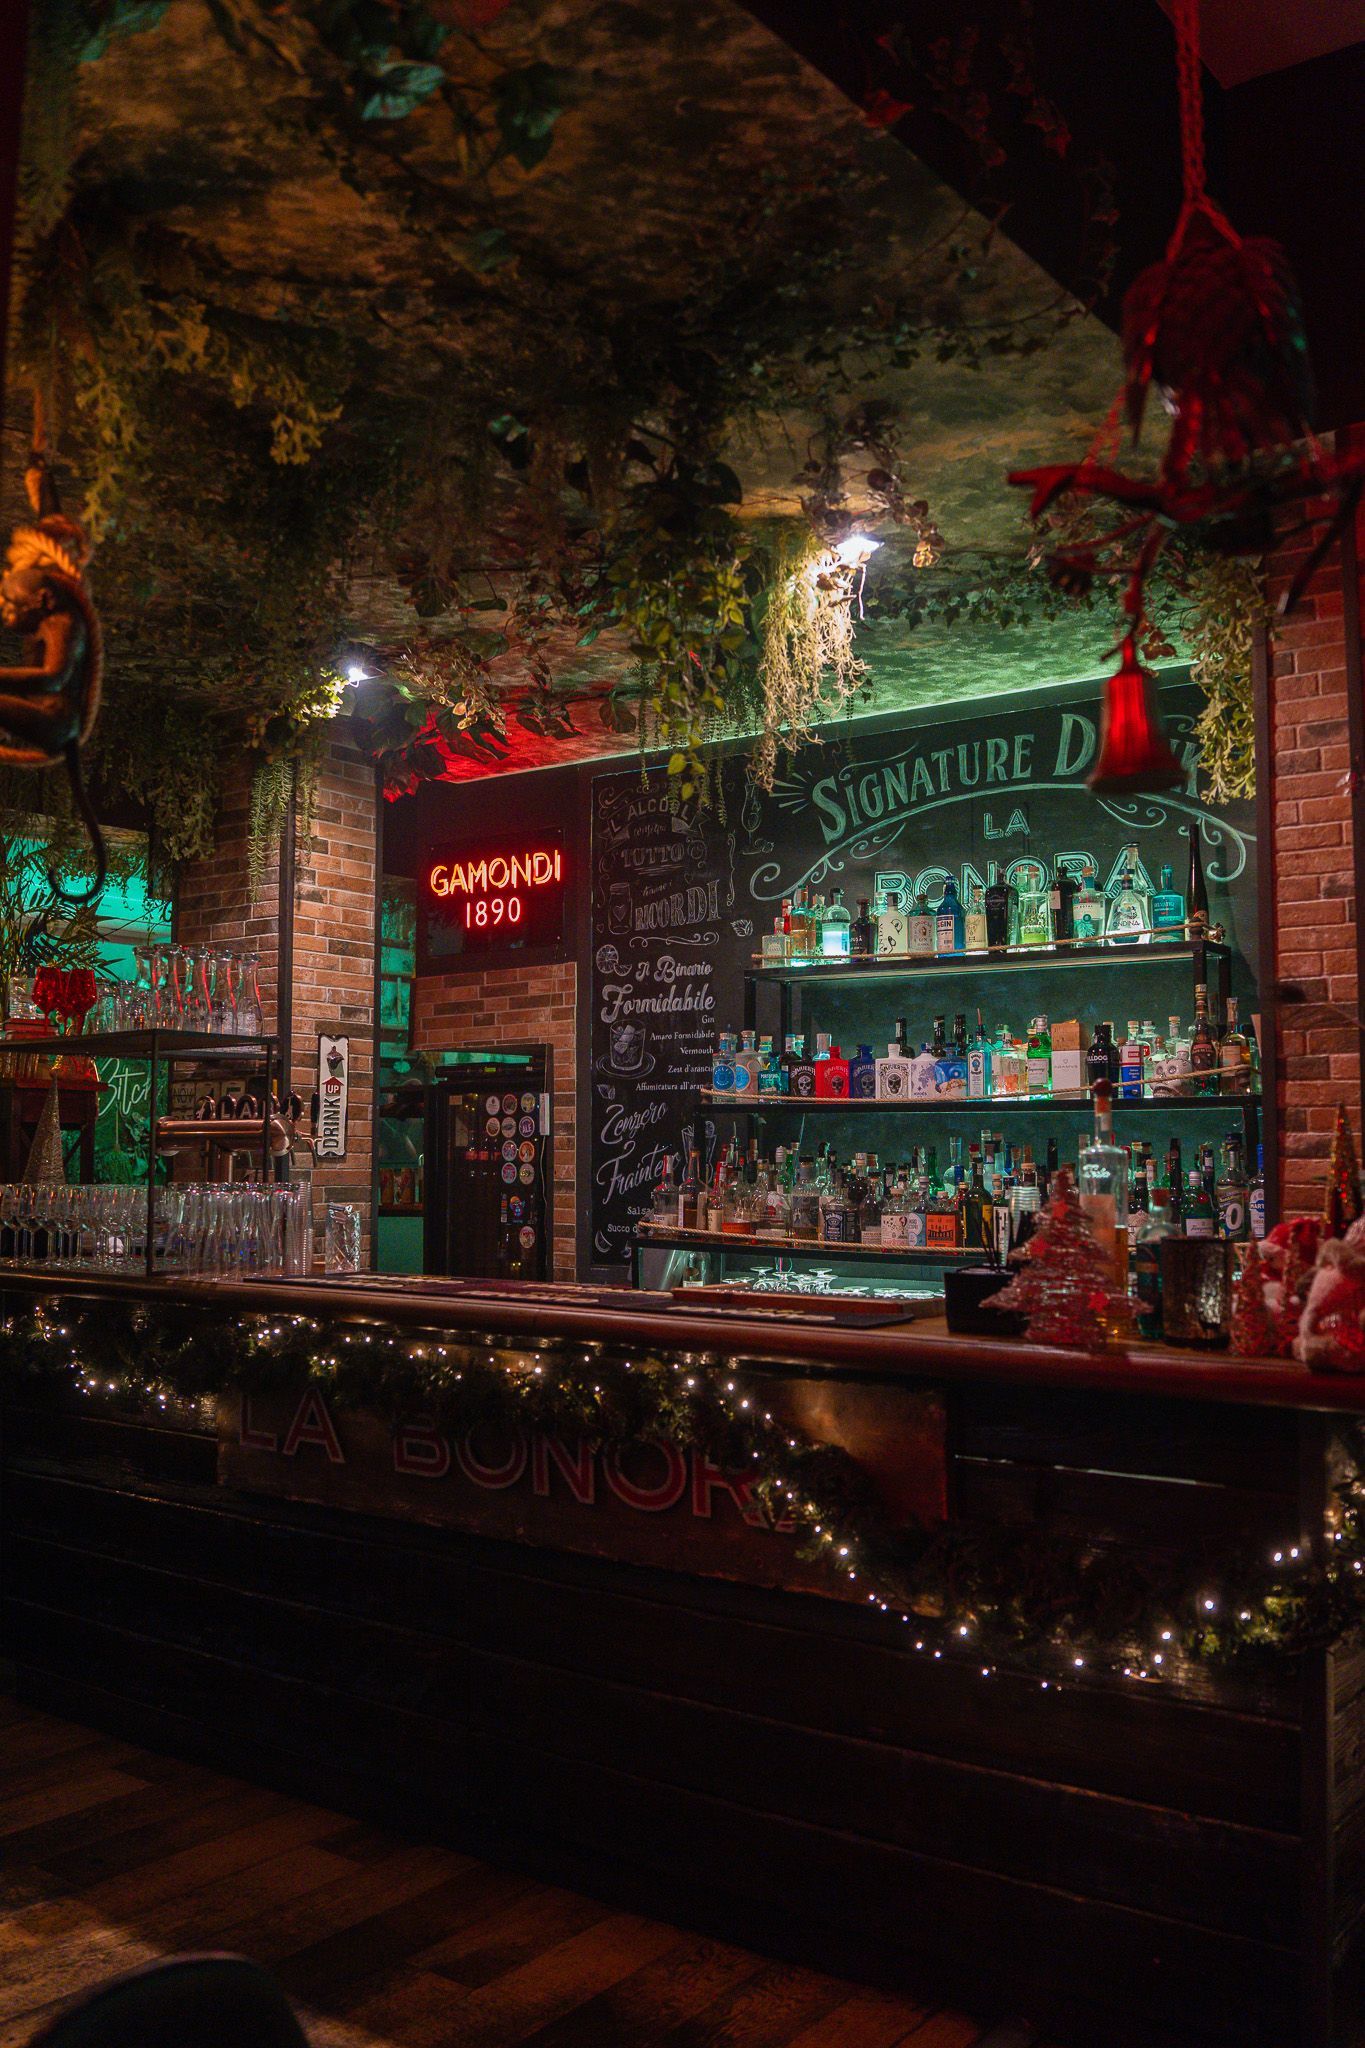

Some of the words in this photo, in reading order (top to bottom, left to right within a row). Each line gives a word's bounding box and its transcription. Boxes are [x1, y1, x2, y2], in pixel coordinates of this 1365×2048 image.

[811, 734, 1035, 845] SIGNATURE
[983, 808, 1031, 840] LA
[620, 843, 686, 869] TUTTO
[430, 849, 561, 897] GAMONDI
[466, 897, 521, 928] 1890
[634, 879, 721, 932] RICORDI
[653, 955, 714, 983] Binario
[600, 983, 717, 1024] Formidabile
[701, 1014, 715, 1025] Gin
[649, 1031, 673, 1043] Amaro
[673, 1029, 716, 1042] Formidabile
[679, 1045, 715, 1057] Vermouth
[667, 1063, 684, 1075] Zest
[327, 1083, 340, 1095] UP
[635, 1081, 678, 1094] Affumicatura
[322, 1097, 342, 1149] DRINK
[600, 1101, 669, 1145] Zenzero
[607, 1222, 631, 1234] Succo
[239, 1387, 347, 1464] LA
[394, 1404, 797, 1533] BONOR
